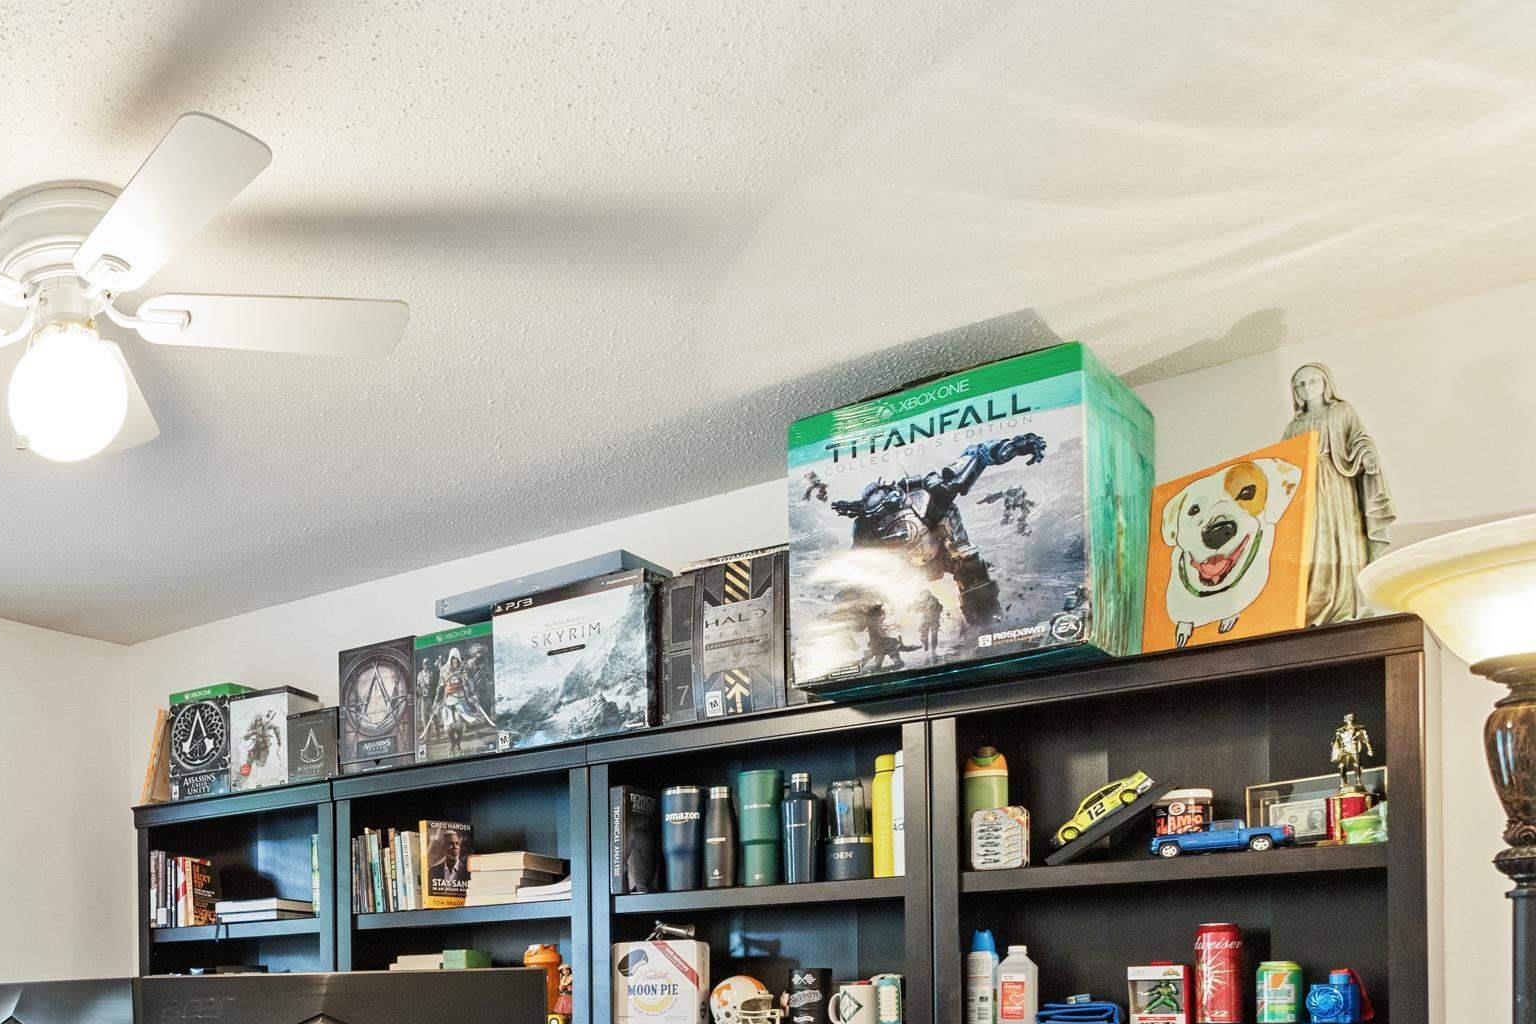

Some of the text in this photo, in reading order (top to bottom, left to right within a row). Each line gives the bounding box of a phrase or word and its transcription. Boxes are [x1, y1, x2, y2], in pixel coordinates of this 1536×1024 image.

[937, 379, 970, 399] ONE
[825, 393, 1031, 463] TITANFALL
[825, 415, 1033, 476] COLLECTOR'S EDITION
[505, 597, 533, 611] PS3
[705, 608, 767, 629] HALO
[1057, 622, 1078, 633] EA
[531, 621, 601, 649] SKYRIM
[676, 685, 689, 705] 7
[183, 773, 216, 786] ASSASSIN'S
[187, 785, 211, 795] UNITY
[665, 812, 700, 821] amazon
[1087, 802, 1106, 821] 12
[431, 822, 471, 831] GREG HARDEN
[432, 878, 451, 887] STAY
[627, 983, 679, 996] MOON PIE
